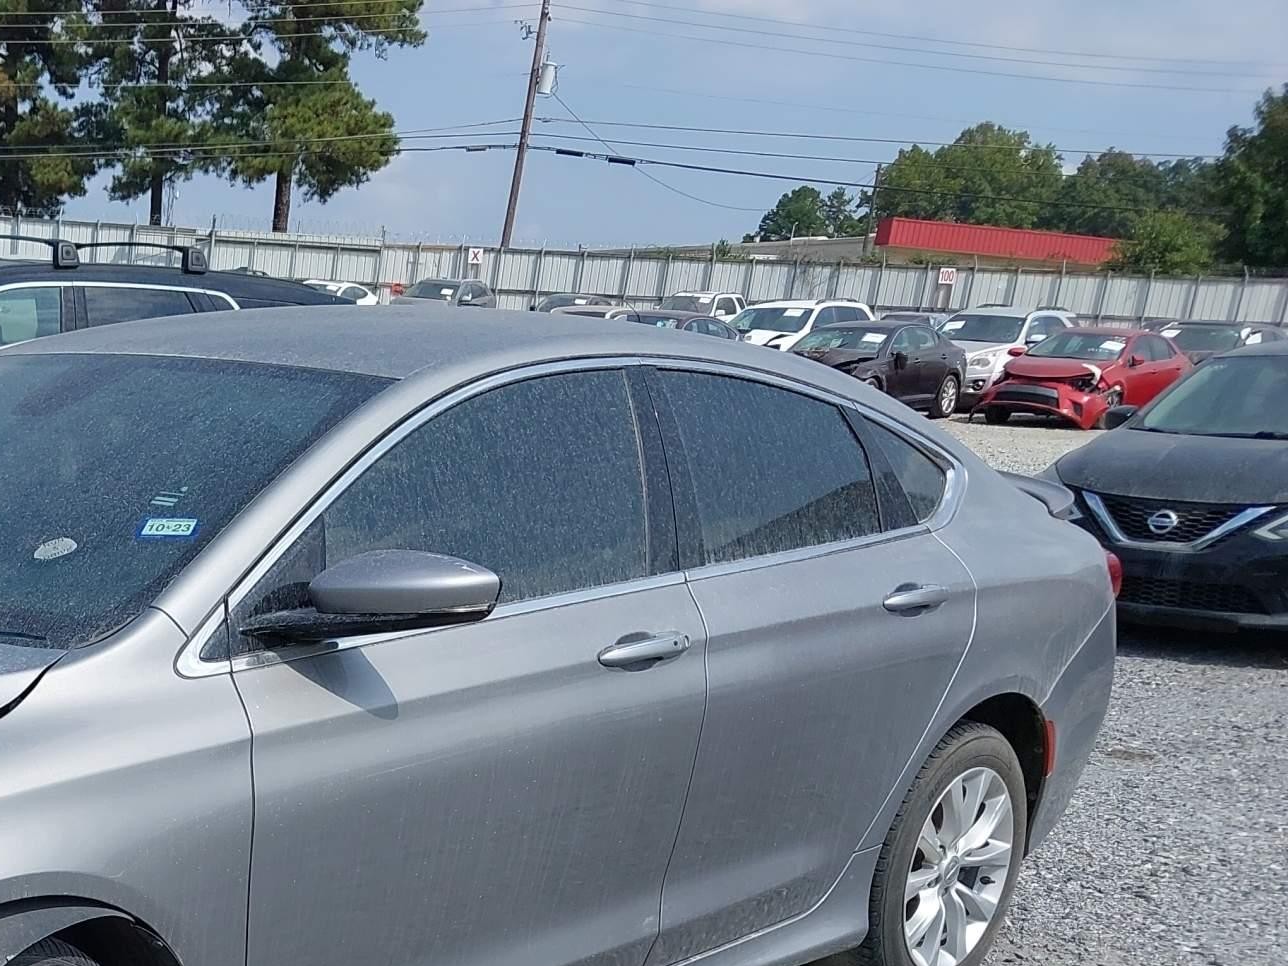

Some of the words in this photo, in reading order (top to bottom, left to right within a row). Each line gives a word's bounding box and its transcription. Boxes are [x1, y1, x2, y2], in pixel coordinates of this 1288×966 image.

[471, 250, 481, 262] X
[940, 270, 954, 282] 100
[172, 523, 192, 532] 23
